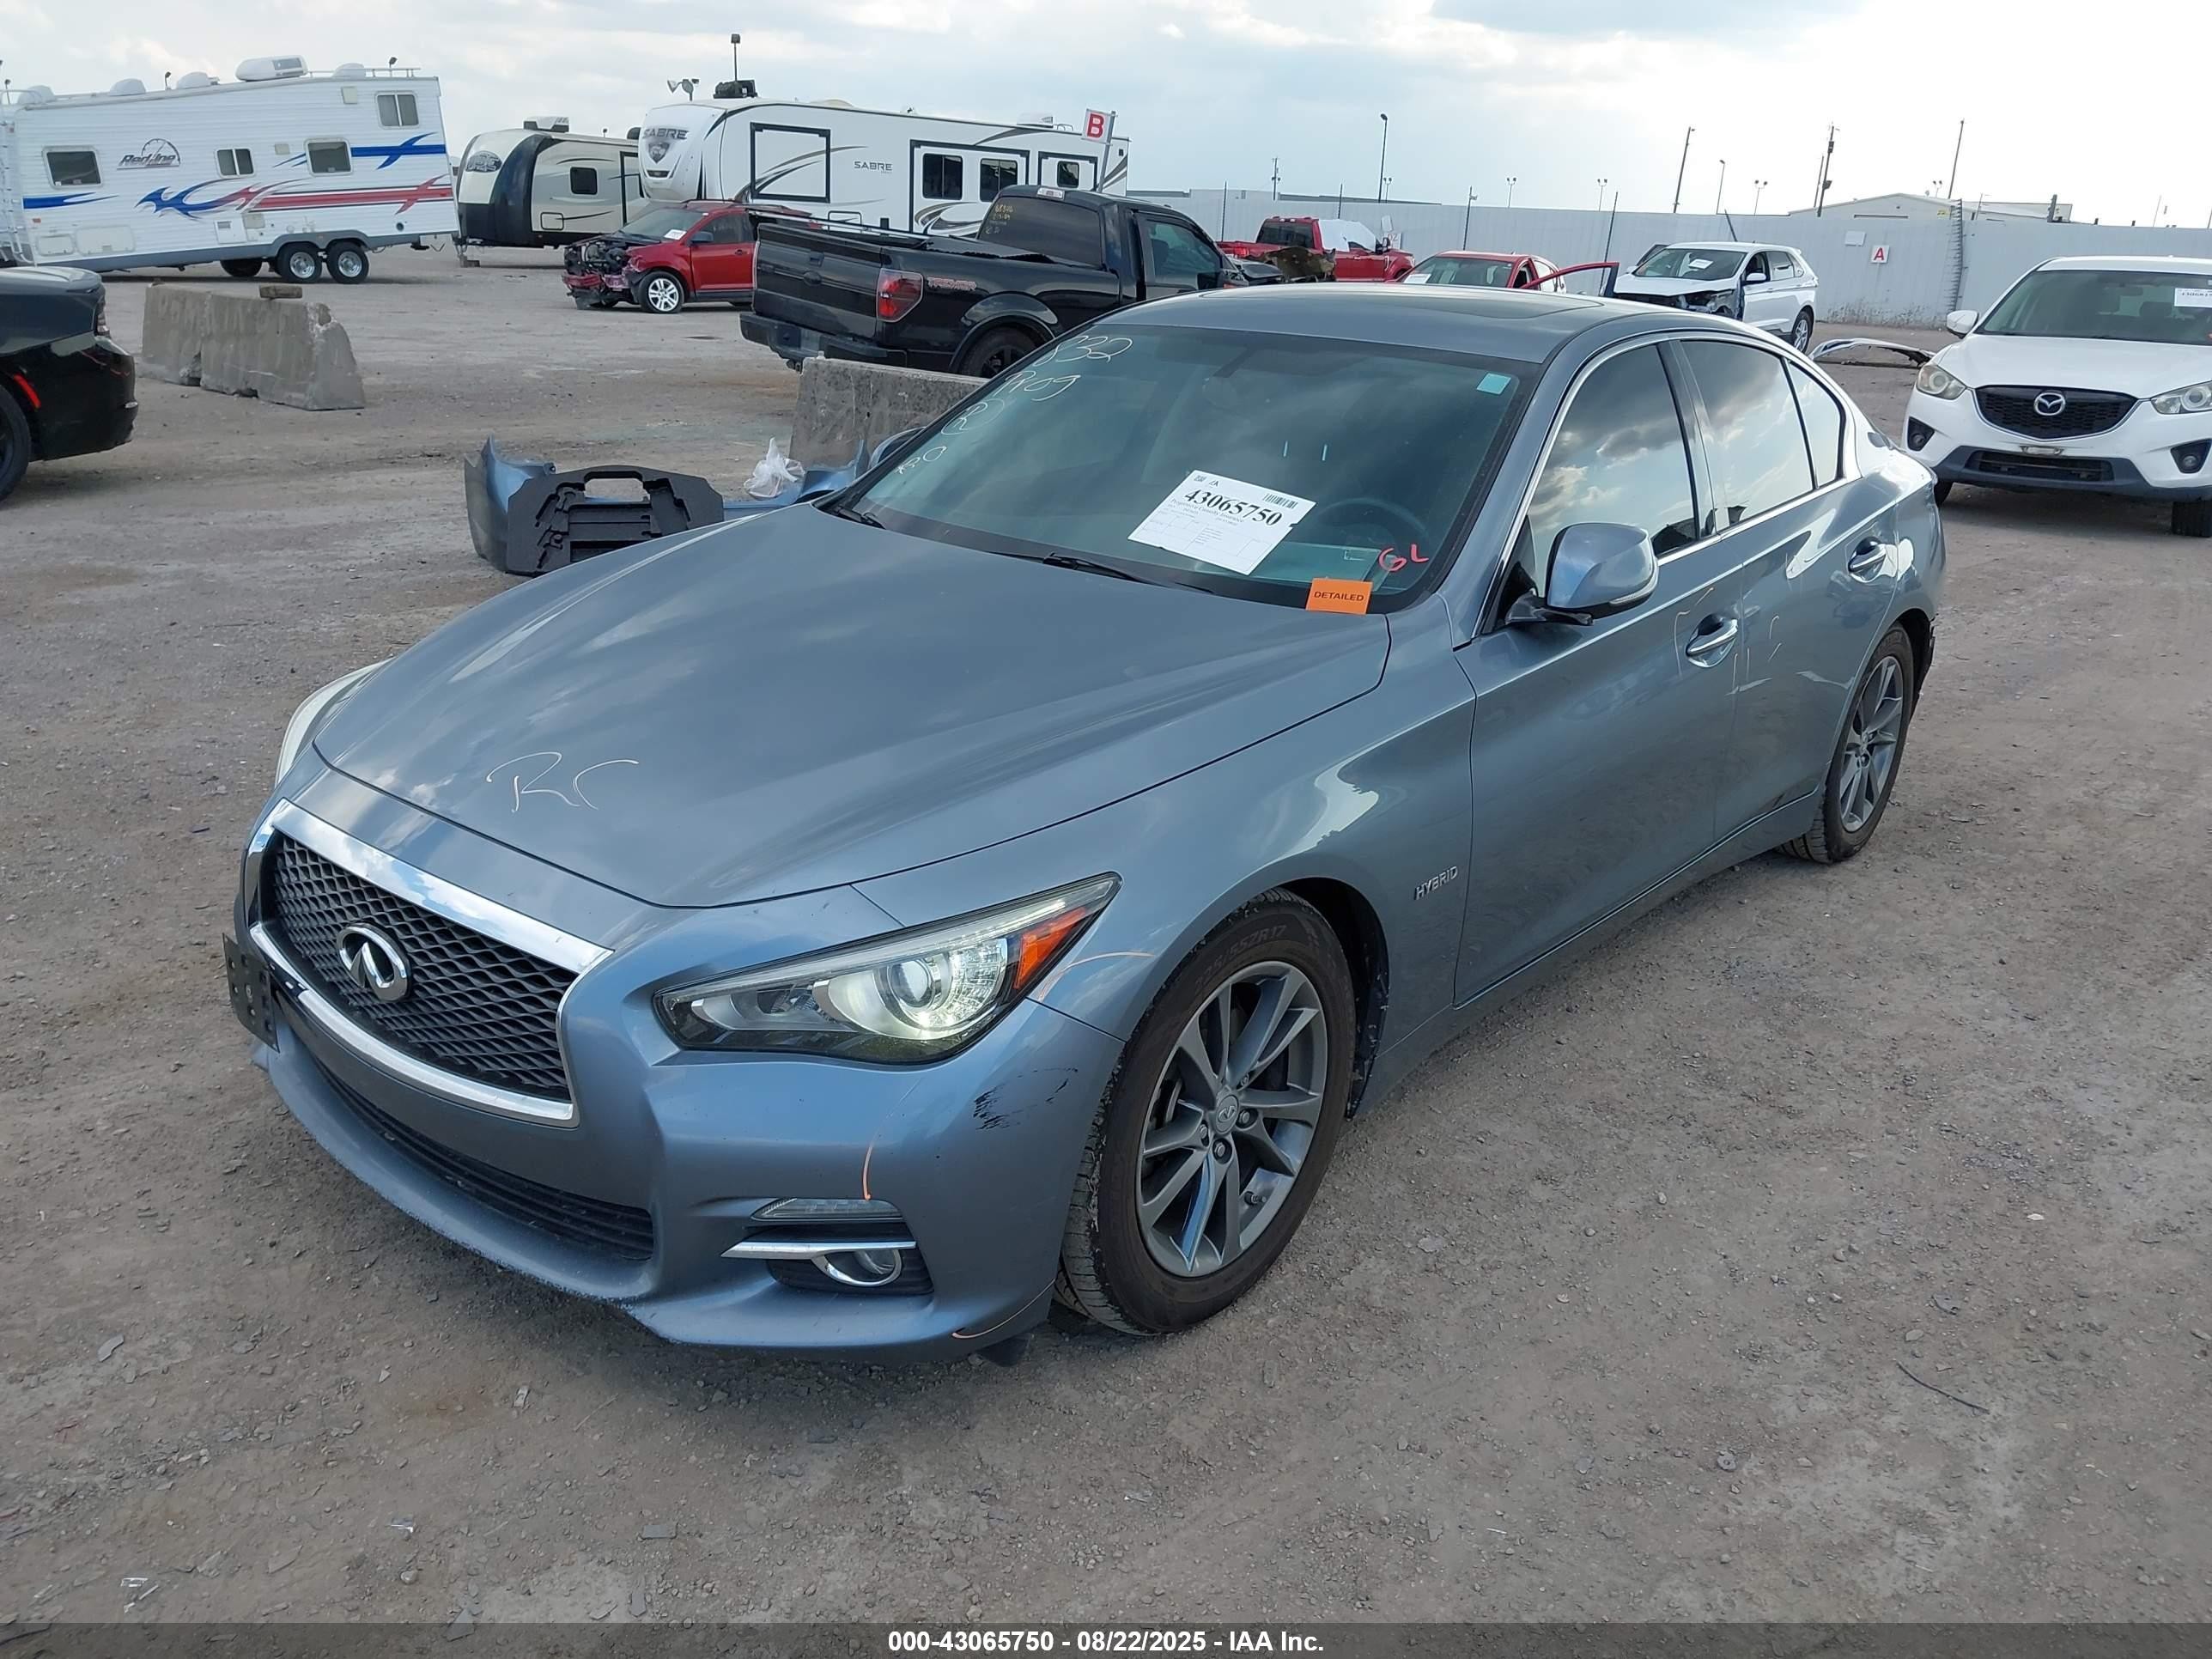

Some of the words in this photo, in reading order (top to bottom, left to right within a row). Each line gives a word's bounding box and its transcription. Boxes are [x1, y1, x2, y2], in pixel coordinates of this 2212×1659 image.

[1087, 113, 1104, 138] B
[643, 128, 689, 140] SABRE
[854, 161, 893, 171] SABRE
[1874, 247, 1885, 261] A
[1184, 489, 1283, 526] 43065750
[1314, 591, 1364, 602] DETAILED
[1414, 866, 1458, 901] HYBRID
